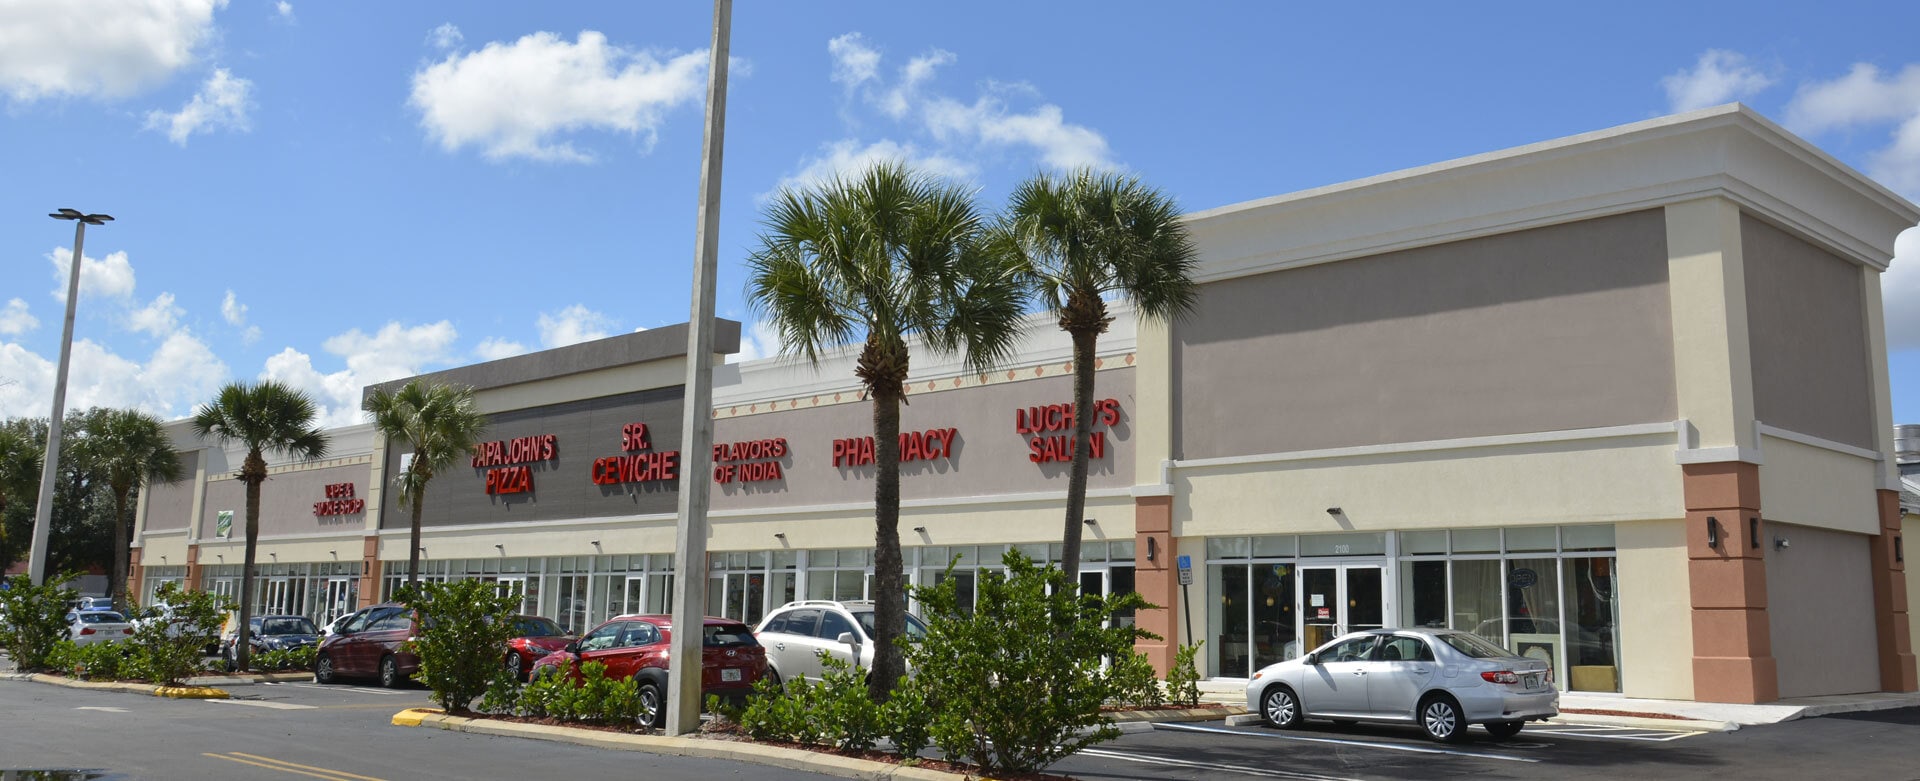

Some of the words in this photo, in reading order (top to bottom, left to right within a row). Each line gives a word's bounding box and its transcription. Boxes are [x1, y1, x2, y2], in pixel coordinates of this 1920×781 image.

[1016, 399, 1120, 434] LUCH'S
[471, 441, 505, 467] PAPA
[504, 434, 557, 465] JOHN'S
[621, 422, 649, 452] SR.
[712, 438, 787, 462] FLAVORS
[833, 428, 957, 467] PHAACY
[485, 466, 532, 495] PIZZA
[592, 451, 679, 485] CEVICHE
[714, 465, 736, 484] OF
[738, 461, 782, 482] INDIA
[313, 501, 339, 517] SMOKE
[339, 499, 364, 515] SHOP
